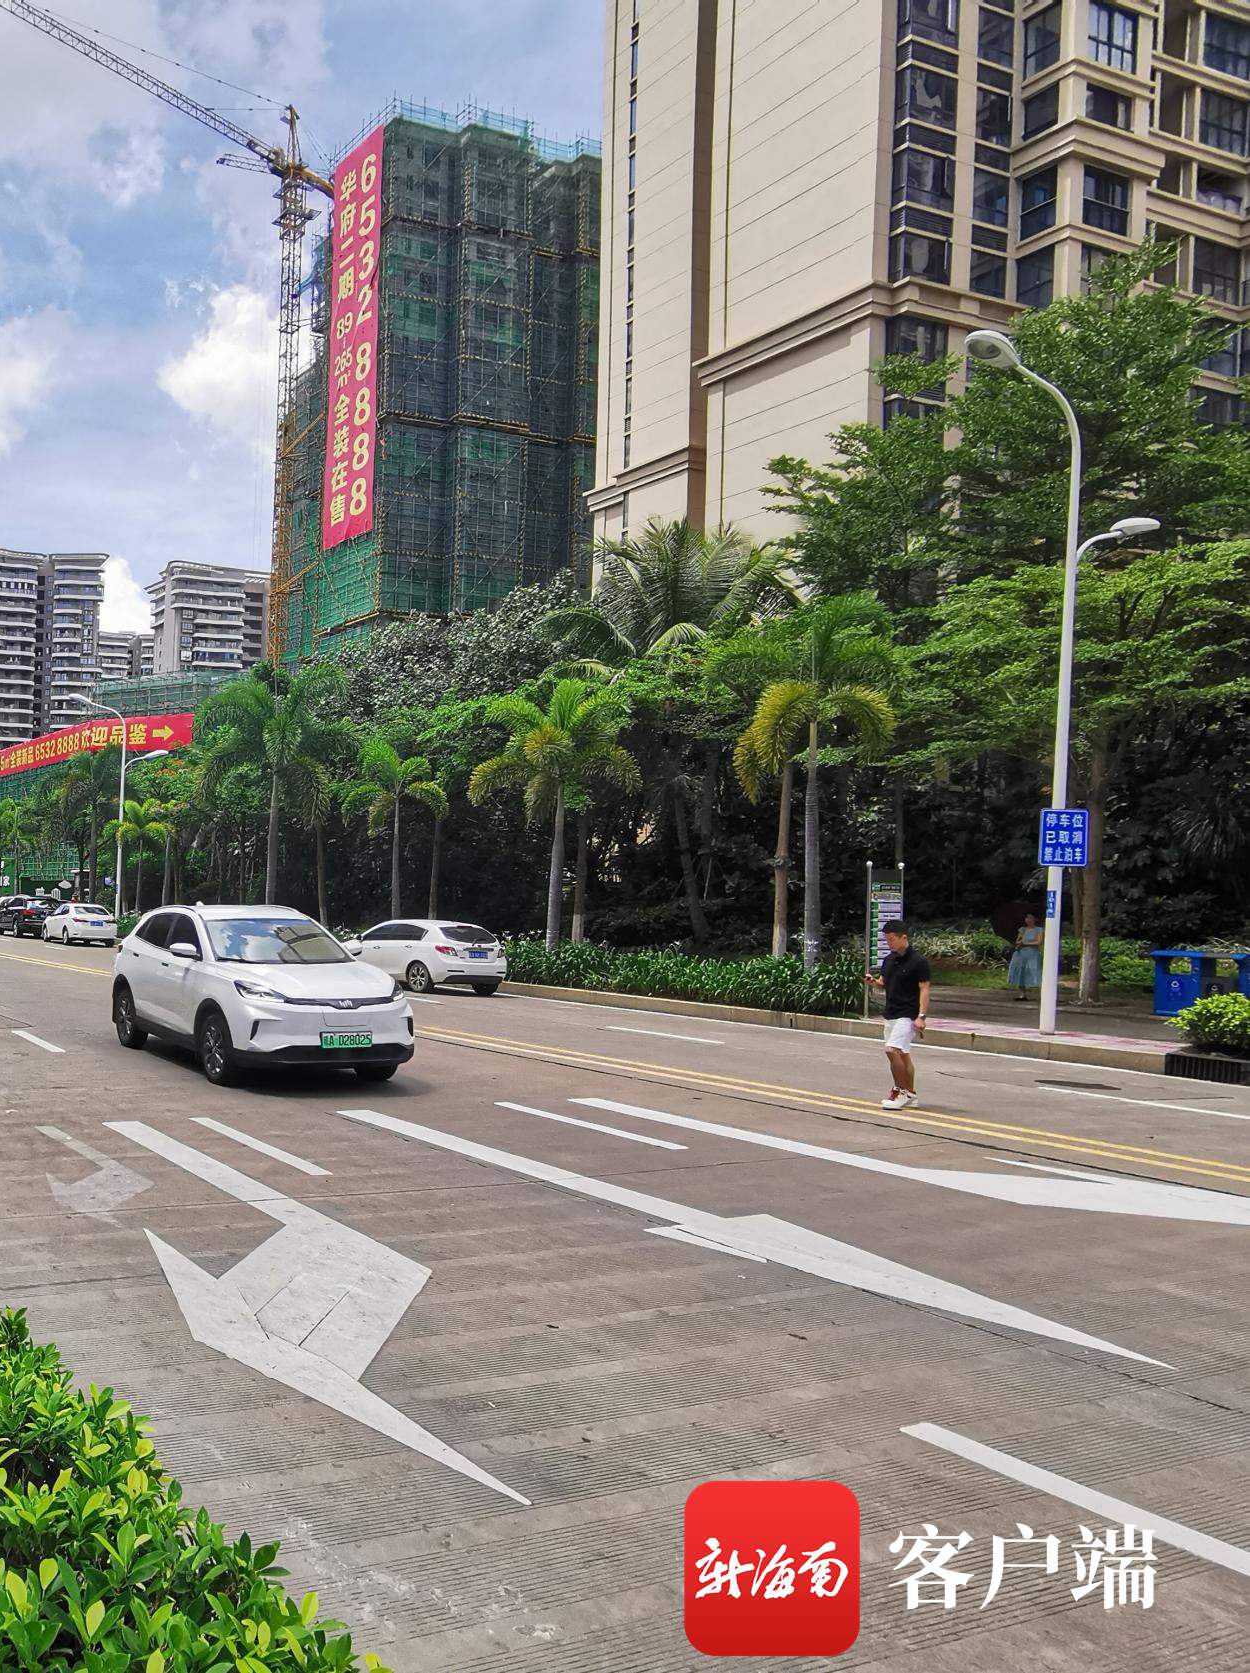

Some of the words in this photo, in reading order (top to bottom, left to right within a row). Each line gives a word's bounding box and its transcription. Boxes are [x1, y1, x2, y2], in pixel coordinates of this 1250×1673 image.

[337, 169, 356, 303] 华府二期
[356, 153, 377, 326] 6532
[330, 393, 350, 528] 全装在售
[349, 341, 371, 516] 8888
[1043, 846, 1083, 862] 禁止泊车
[1045, 813, 1084, 828] 停车位
[1045, 830, 1083, 844] 已取消
